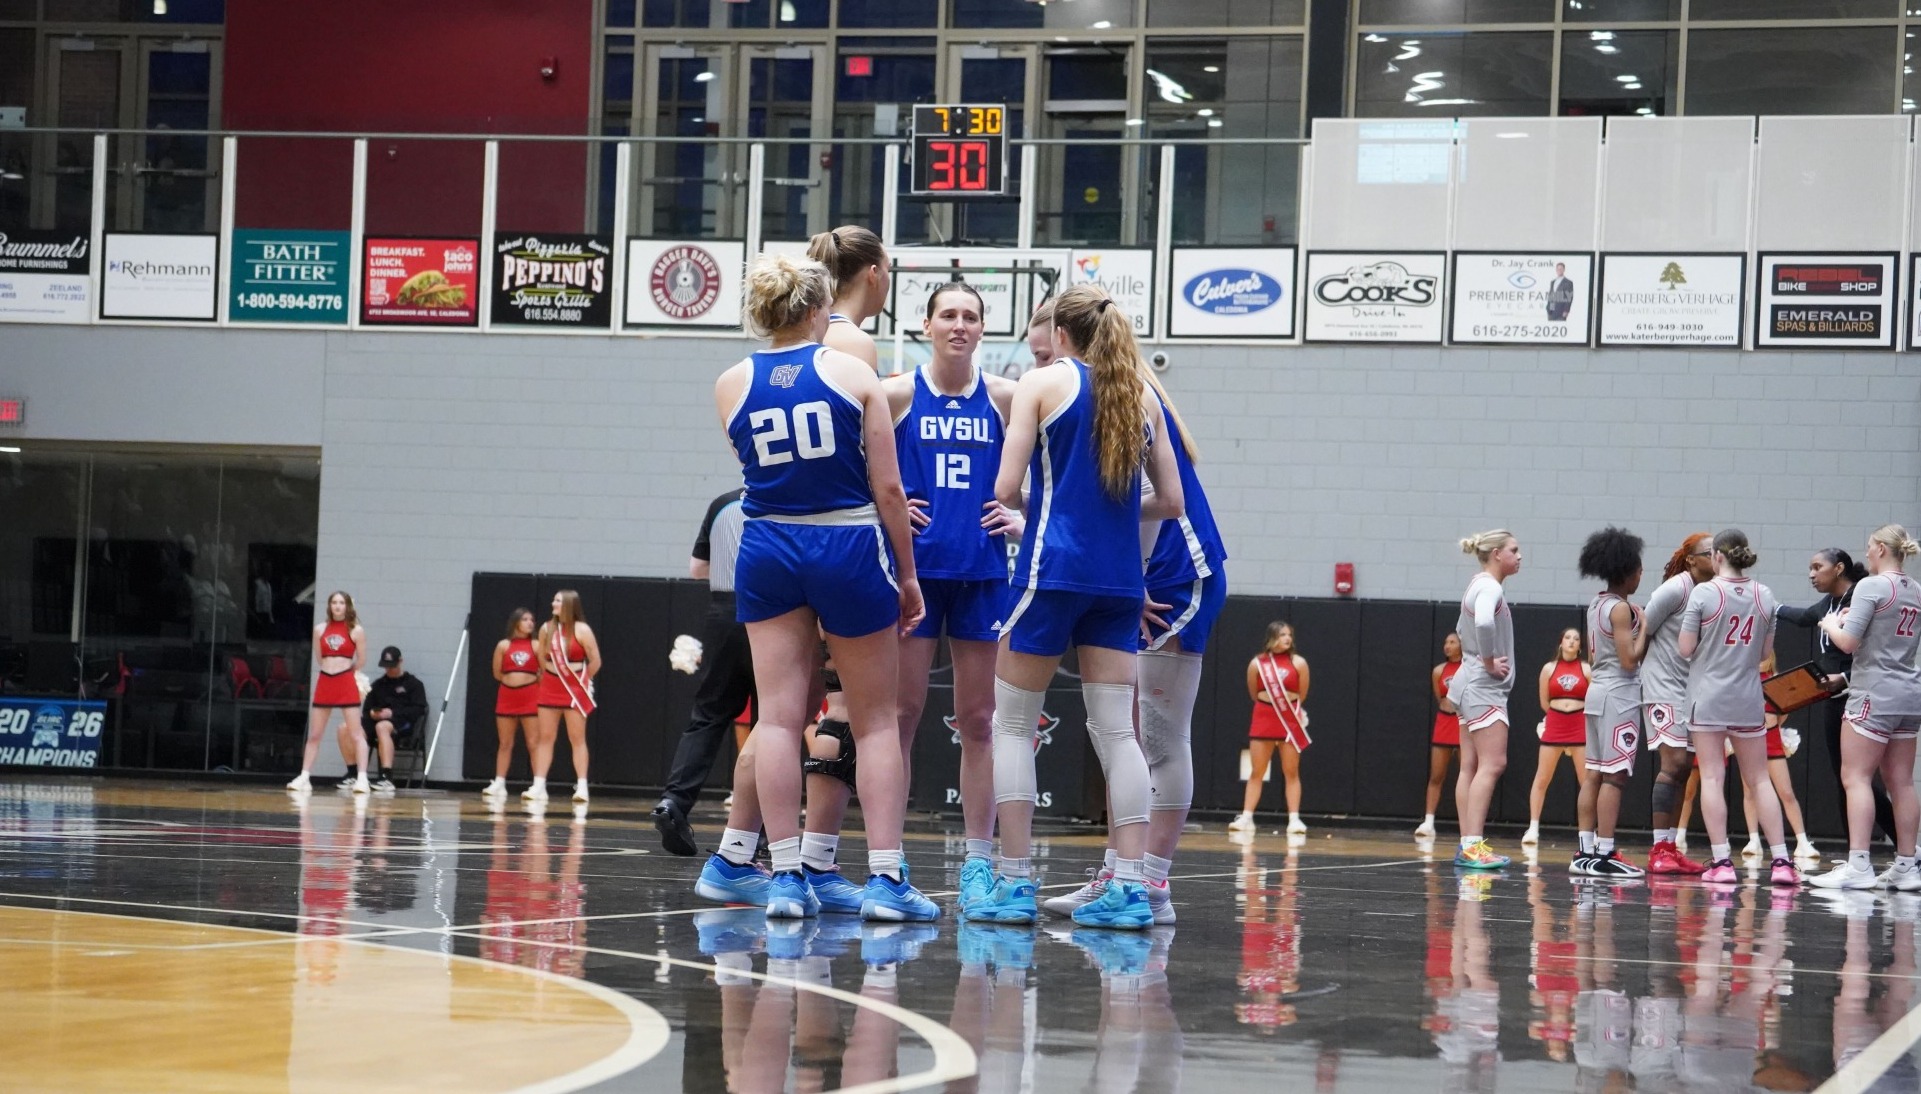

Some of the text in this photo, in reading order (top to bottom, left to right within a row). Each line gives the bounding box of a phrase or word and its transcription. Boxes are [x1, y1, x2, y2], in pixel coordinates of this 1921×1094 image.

[929, 142, 986, 189] 30
[263, 244, 320, 260] BATH
[370, 247, 426, 257] BREAKFAST.
[444, 249, 474, 262] taco
[525, 237, 583, 259] Pizzeria
[19, 260, 68, 269] FURNISHINGS
[122, 260, 211, 279] Rehmann
[370, 258, 405, 268] LUNCH.
[444, 261, 473, 273] john's
[1492, 259, 1554, 270] Dr. Jay Crank
[370, 268, 408, 278] DINNER.
[502, 253, 605, 294] PEPPINO'S
[1192, 272, 1263, 307] Culver's
[1777, 282, 1878, 291] BIKE SHOP
[237, 292, 343, 310] 1-800-594-8776
[510, 289, 552, 309] Sports
[1469, 291, 1525, 301] PREMIER
[1606, 293, 1738, 305] KATERBERG VERHAGE
[1777, 311, 1874, 321] EMERALD
[1473, 325, 1568, 337] 616-275-2020
[1776, 322, 1875, 332] SPAS & BILLIARDS
[1606, 332, 1734, 343] www.katerbergverhage.com
[770, 364, 803, 388] GV
[749, 400, 836, 467] 20
[920, 416, 988, 442] GVSU
[936, 453, 971, 489] 12
[1895, 606, 1918, 637] 22
[1724, 615, 1755, 646] 24
[67, 711, 104, 737] 26
